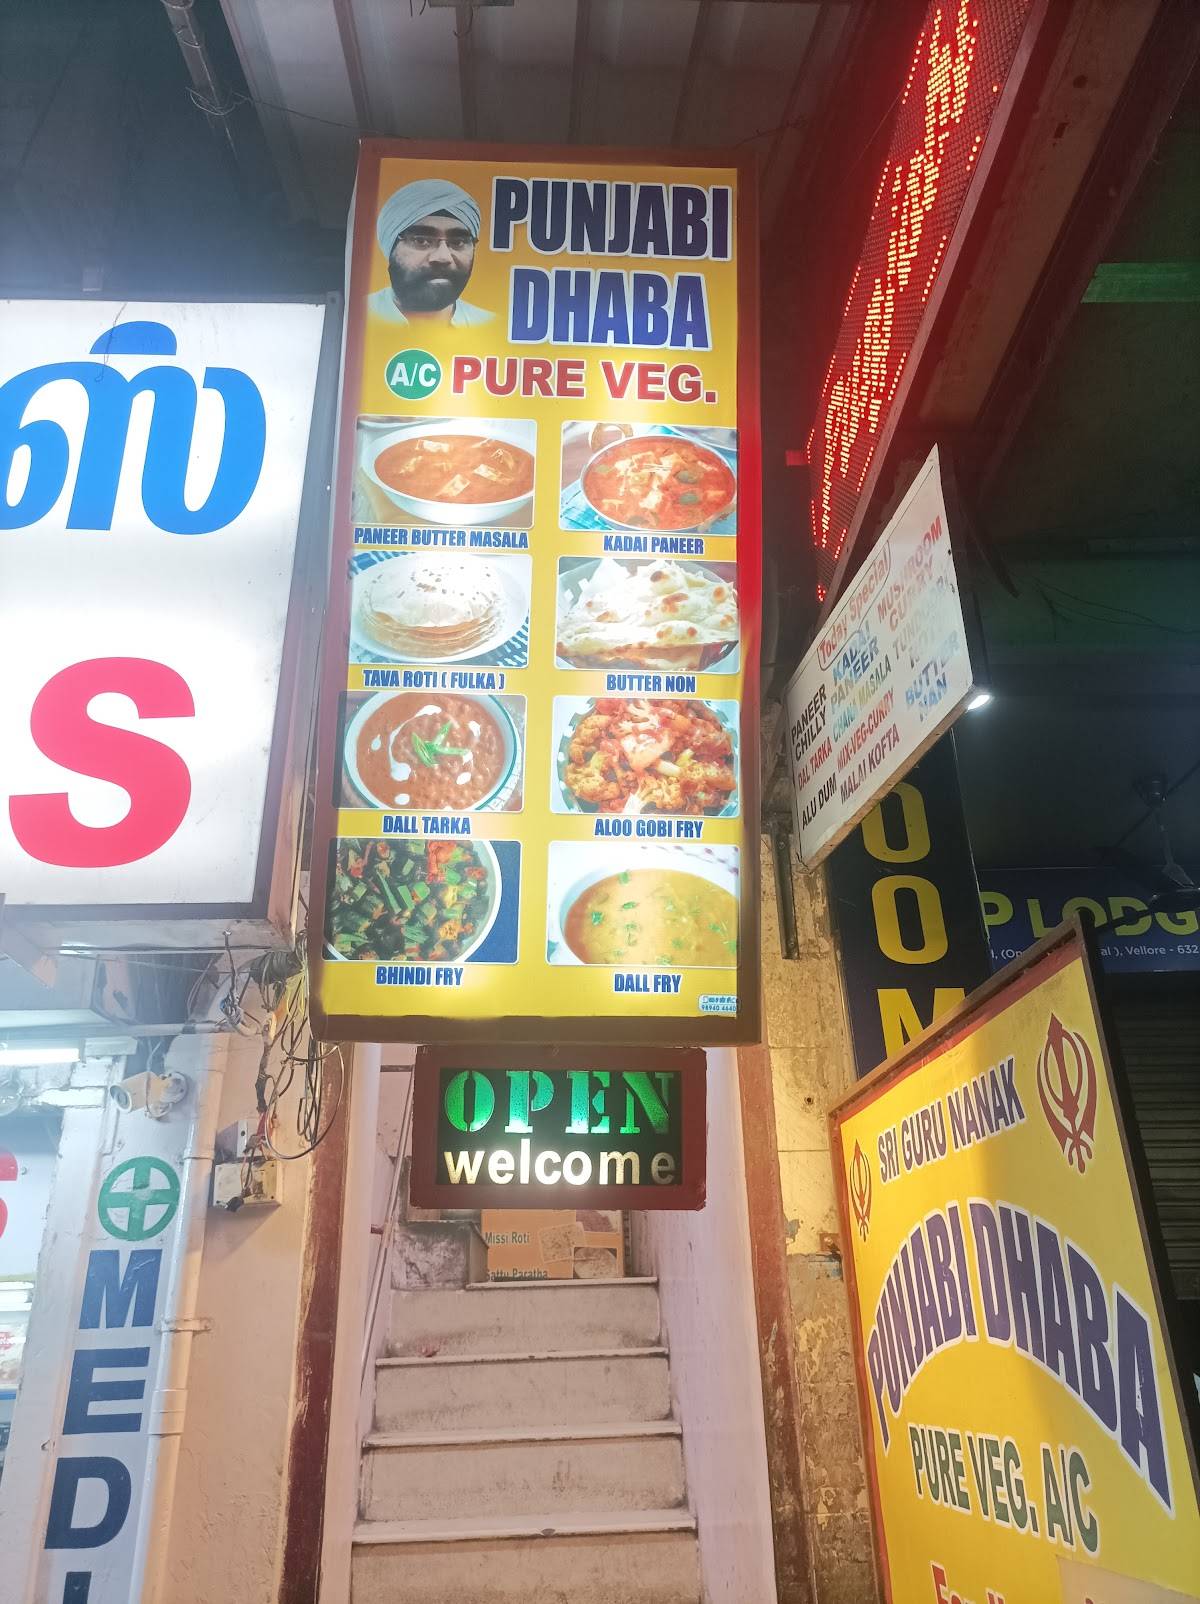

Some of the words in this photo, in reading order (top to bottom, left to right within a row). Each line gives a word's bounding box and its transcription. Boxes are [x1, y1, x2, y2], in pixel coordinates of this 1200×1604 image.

[492, 179, 730, 258] PUNJABI
[512, 268, 709, 347] DHABA
[390, 361, 437, 388] A/C
[453, 357, 585, 397] PURE
[602, 362, 717, 402] VEG.
[354, 528, 407, 544] PANEER
[412, 529, 466, 546] BUTTER
[470, 531, 528, 548] MASALA
[604, 535, 647, 552] KADAI
[651, 537, 704, 554] PANEER
[819, 615, 848, 663] Today
[849, 550, 888, 621] Special
[363, 670, 400, 687] TAVA
[403, 671, 437, 688] ROTI
[607, 675, 661, 692] BUTTER
[666, 676, 695, 692] NON
[831, 636, 879, 714] PANEER
[858, 654, 891, 707] MASALA
[791, 684, 827, 744] PANEER
[795, 705, 826, 761] CHILLY
[9, 657, 195, 868] S
[798, 772, 811, 791] DAL
[810, 736, 832, 774] TARKA
[840, 760, 866, 805] MALAI
[869, 723, 900, 773] KOFTA
[383, 816, 418, 833] DALL
[422, 817, 471, 834] TARKA
[802, 801, 817, 830] ALU
[818, 772, 837, 810] DUM
[595, 819, 632, 836] ALOO
[636, 820, 672, 837] GOBI
[676, 821, 703, 838] FRY
[377, 966, 431, 985] BHINDI
[435, 967, 463, 985] FRY
[1125, 945, 1166, 955] Vellore
[1177, 944, 1199, 954] 632
[614, 974, 650, 992] DALL
[654, 975, 681, 992] FRY
[445, 1070, 674, 1134] OPEN
[878, 1128, 899, 1183] SRI
[901, 1102, 946, 1171] GURU
[947, 1058, 1025, 1149] NANAK
[444, 1138, 675, 1185] welcome
[485, 1232, 510, 1244] Missi
[512, 1232, 530, 1244] Roti
[868, 1206, 977, 1449] PUNJABI
[970, 1203, 1172, 1510] DHABA
[909, 1426, 971, 1509] PURE
[967, 1435, 1039, 1533] VEG.
[1042, 1447, 1098, 1552] A/C
